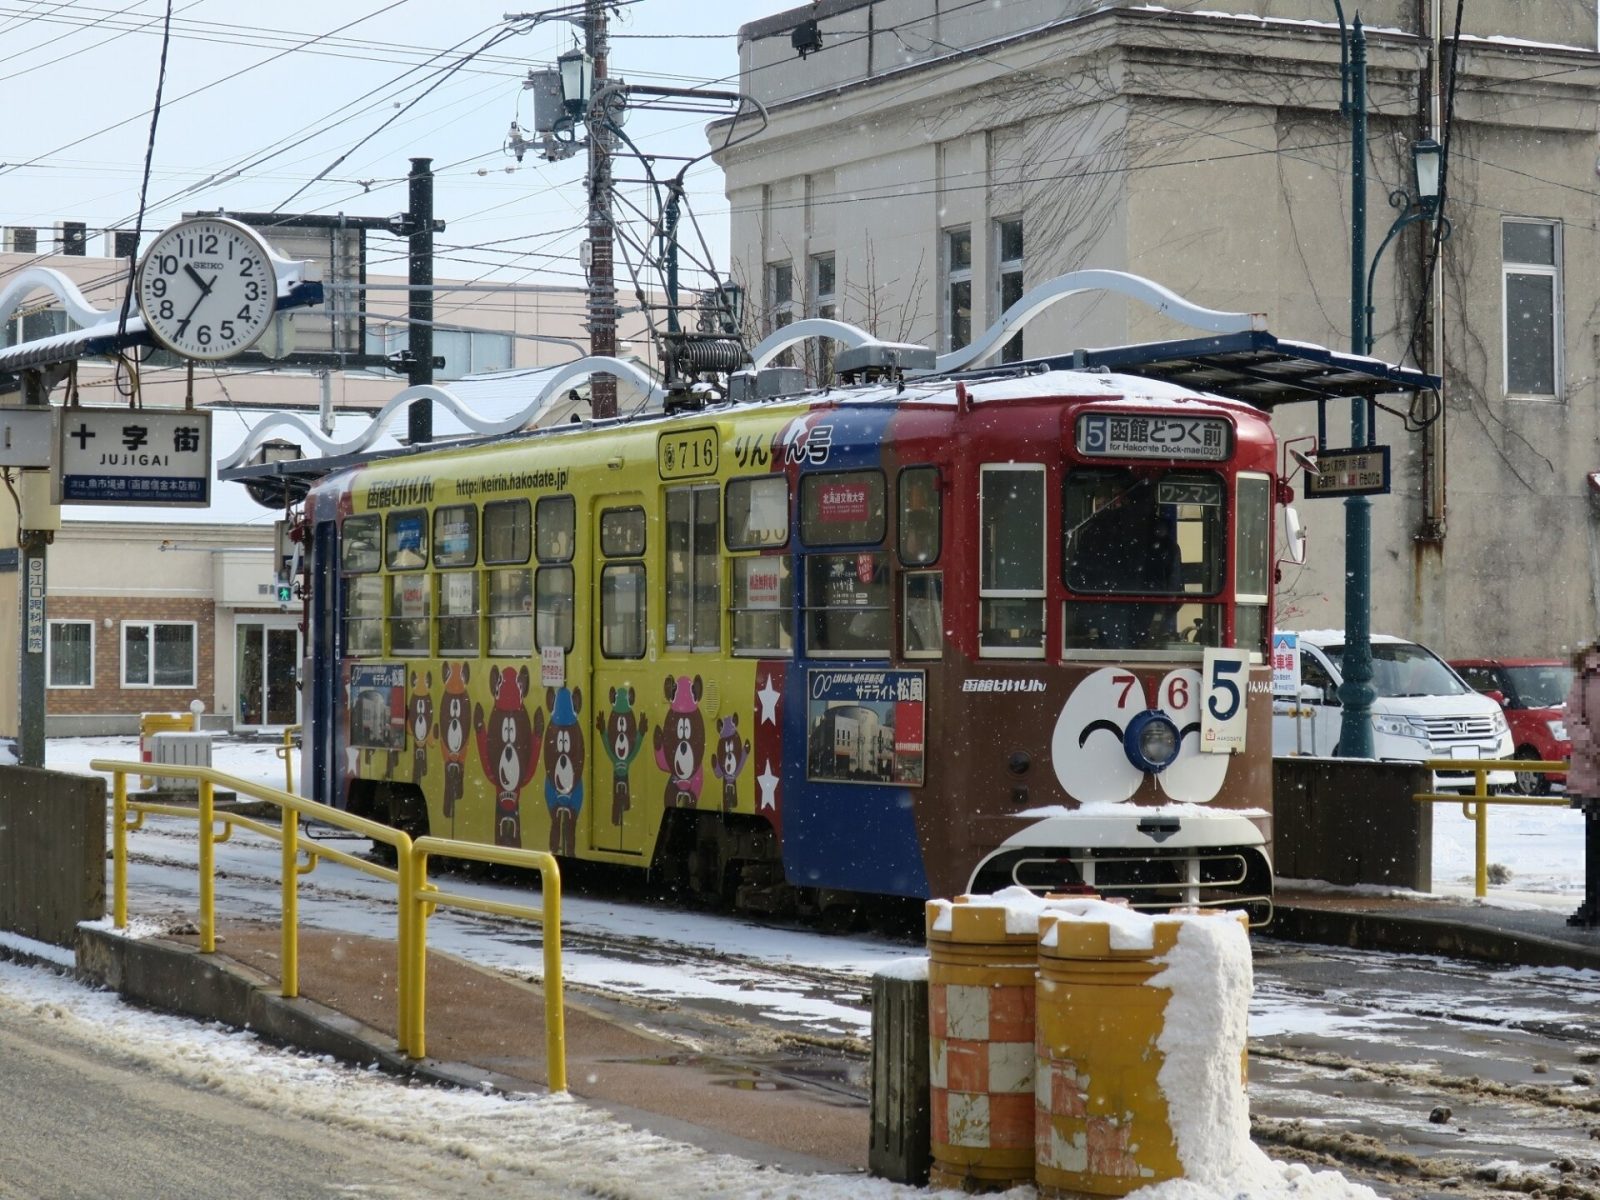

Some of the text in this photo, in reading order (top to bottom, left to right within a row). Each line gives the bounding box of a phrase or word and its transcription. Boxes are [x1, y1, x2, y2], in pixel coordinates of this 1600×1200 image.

[179, 238, 193, 258] 11
[199, 234, 218, 254] 12
[229, 241, 233, 260] 1
[158, 254, 178, 275] 10
[192, 261, 224, 270] SEIKO
[240, 258, 253, 277] 2
[152, 278, 167, 298] 9
[245, 281, 259, 301] 3
[159, 300, 174, 320] 8
[237, 304, 252, 323] 4
[177, 319, 191, 338] 7
[197, 325, 212, 345] 6
[220, 321, 234, 340] 5
[71, 423, 200, 452] 十字街
[1087, 421, 1104, 447] 5
[1110, 418, 1222, 447] 函館どつく前
[678, 439, 713, 469] 716
[734, 425, 834, 469] りんりん号
[1110, 443, 1121, 451] for
[99, 453, 169, 466] JUJIGAI
[456, 467, 570, 497] http://keirin.hakodate.jp/
[1162, 485, 1218, 503] ワンマン
[30, 575, 42, 649] 江口眼科病院
[1273, 653, 1294, 671] 車場
[962, 679, 1047, 692] 函館けいりん
[1208, 660, 1243, 721] 5
